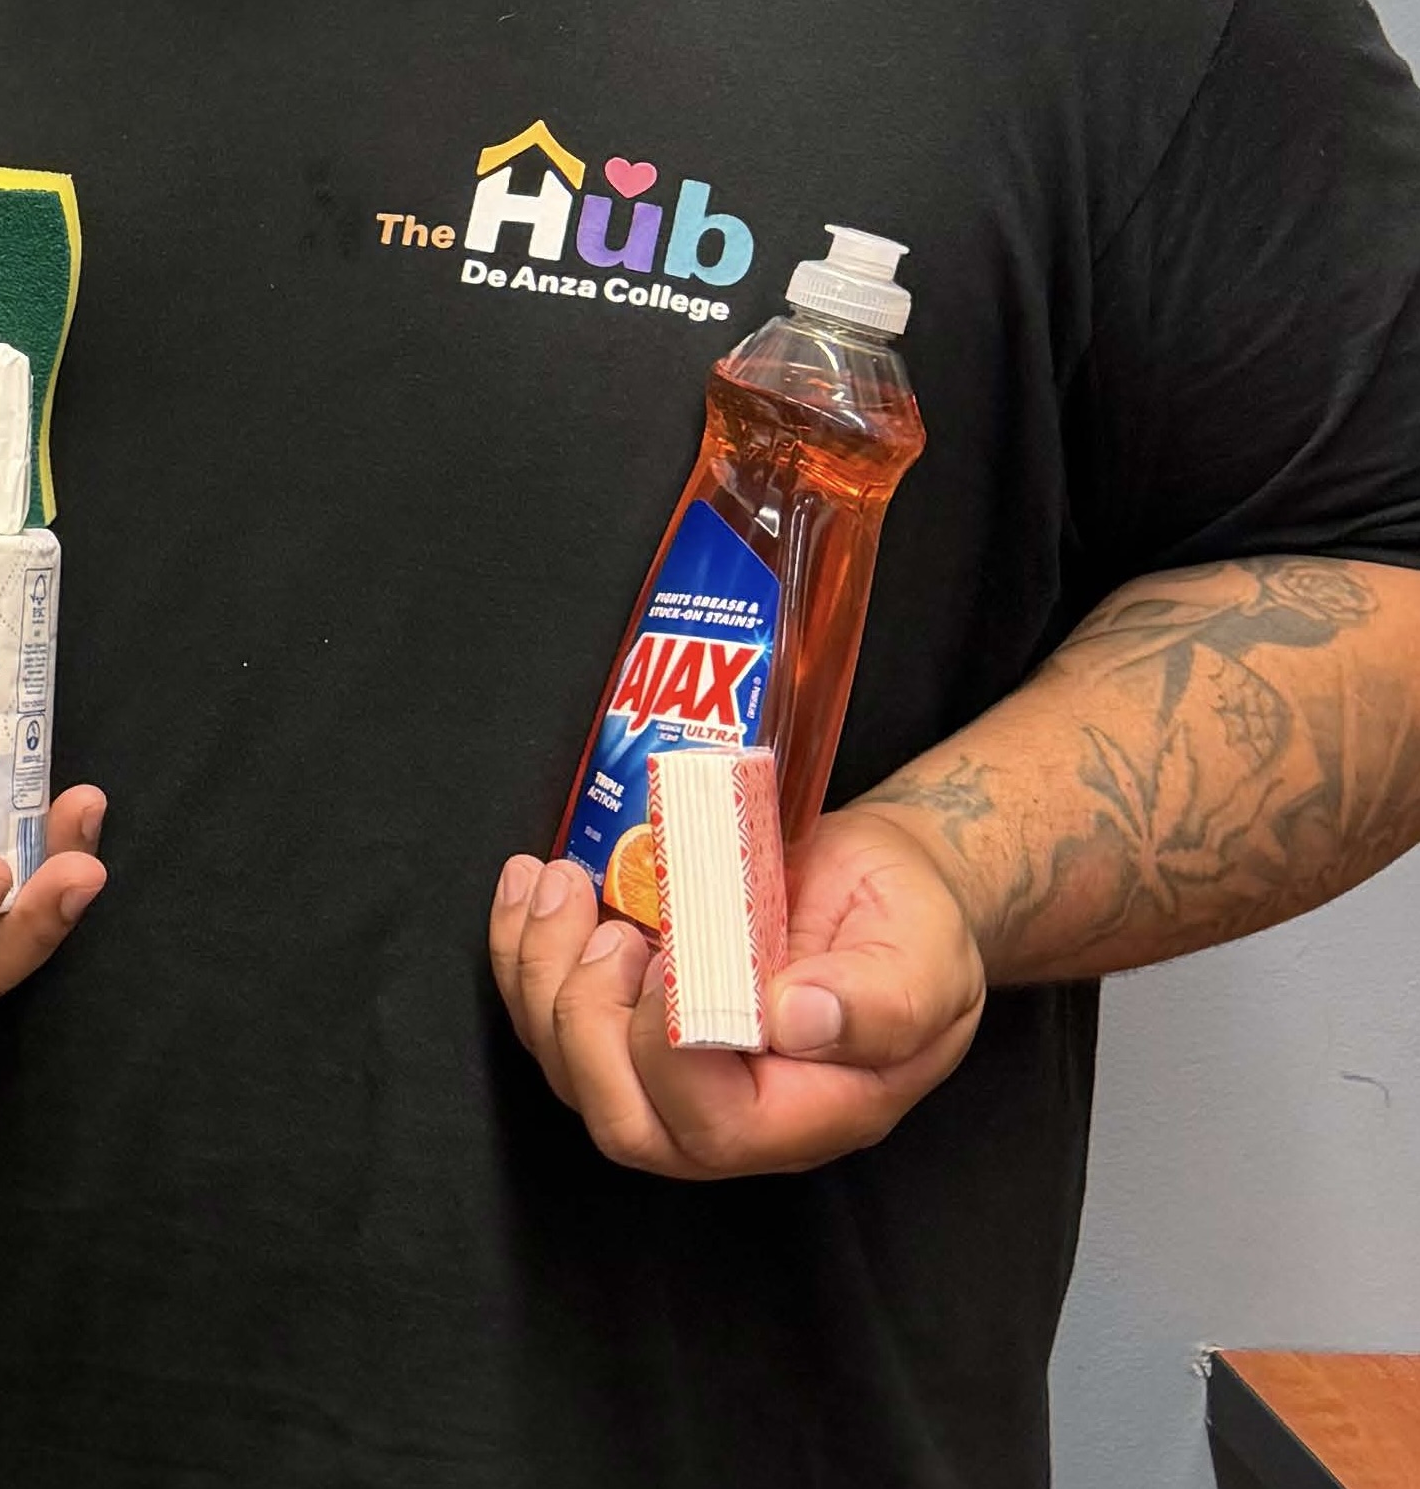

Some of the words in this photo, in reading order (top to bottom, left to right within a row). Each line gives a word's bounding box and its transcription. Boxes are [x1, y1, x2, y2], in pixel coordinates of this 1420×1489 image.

[376, 213, 456, 248] The
[464, 166, 754, 287] Hub
[461, 259, 506, 288] De
[511, 266, 596, 299] Anza
[604, 277, 730, 322] College
[692, 595, 744, 613] GREASE
[613, 636, 759, 731] AJAX
[686, 725, 739, 744] ULTRA
[594, 771, 625, 798] TRIPLE
[587, 786, 623, 813] ACTION
